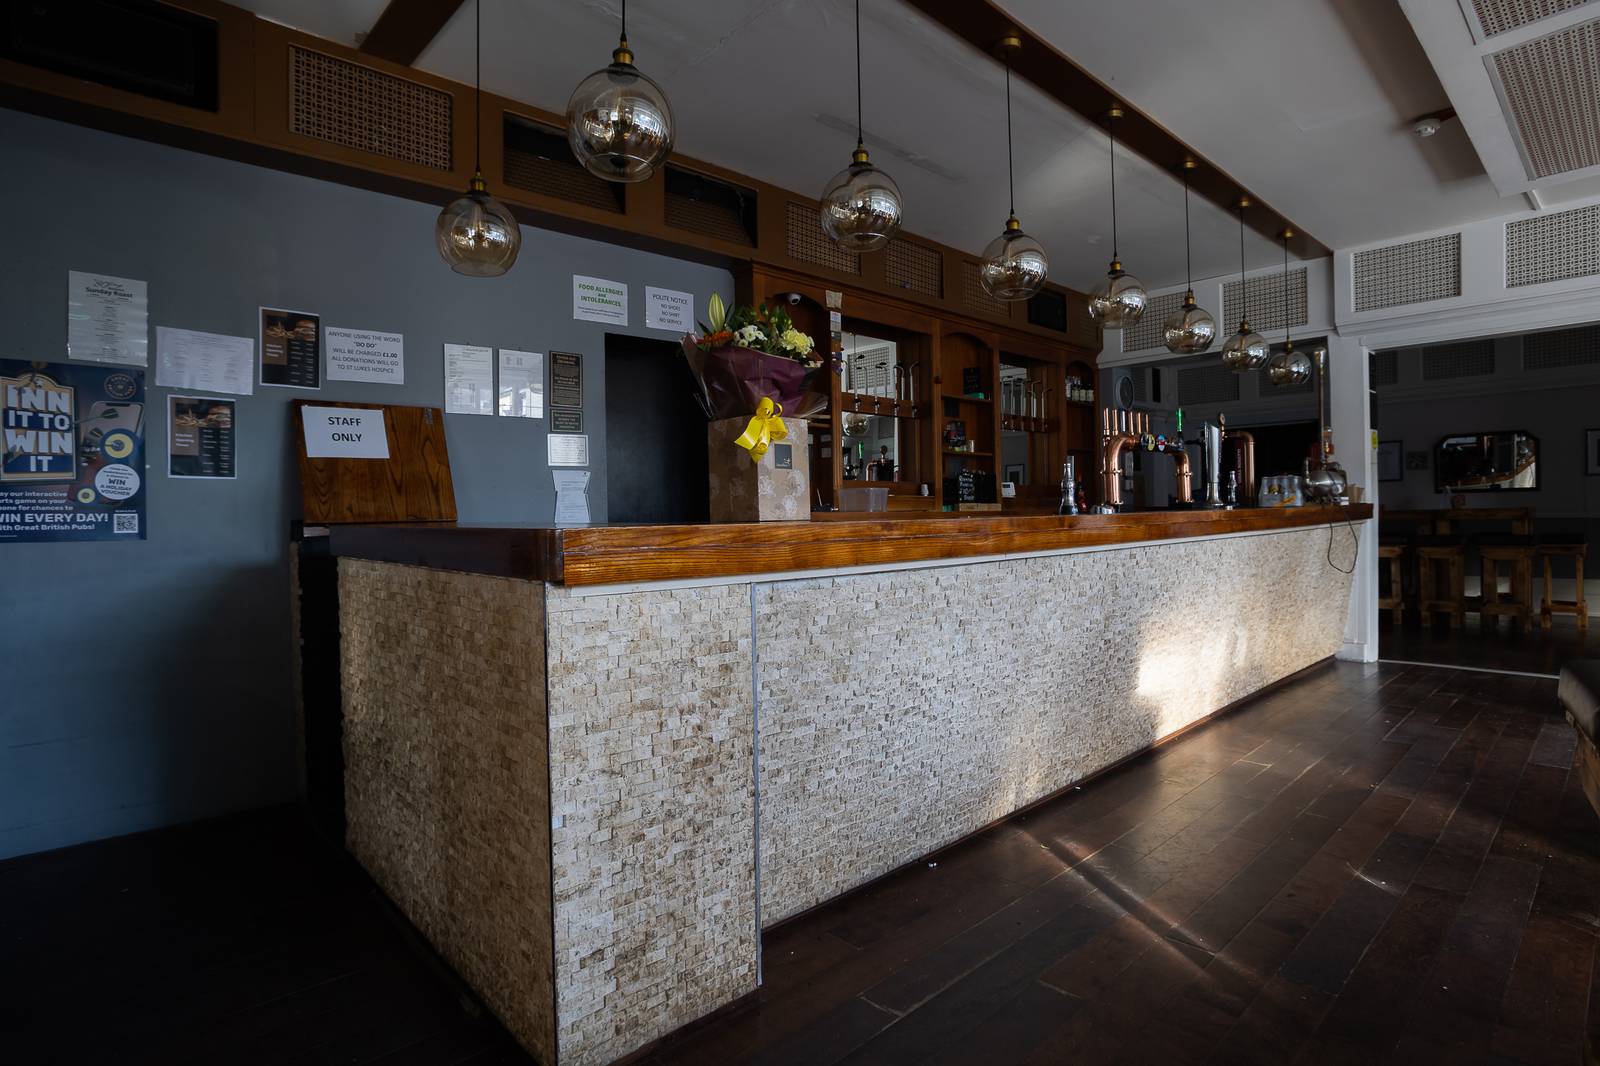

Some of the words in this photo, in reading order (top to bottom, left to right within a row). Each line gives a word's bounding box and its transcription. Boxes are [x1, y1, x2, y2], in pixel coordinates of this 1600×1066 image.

[85, 286, 112, 296] Sunday
[113, 290, 133, 298] Roast
[578, 283, 595, 291] FOOD
[595, 286, 624, 296] ALLERGIES
[580, 295, 621, 307] INTOLERANCES
[670, 296, 688, 305] NOTICE
[7, 384, 70, 413] INN
[8, 410, 33, 427] IT
[38, 413, 70, 430] TO
[327, 416, 362, 426] STAFF
[5, 429, 72, 454] WIN
[331, 432, 362, 442] ONLY
[30, 455, 53, 472] IT
[108, 478, 126, 486] WIN
[101, 488, 130, 496] VOUCHER
[24, 513, 73, 523] EVERY
[76, 513, 109, 522] DAY!
